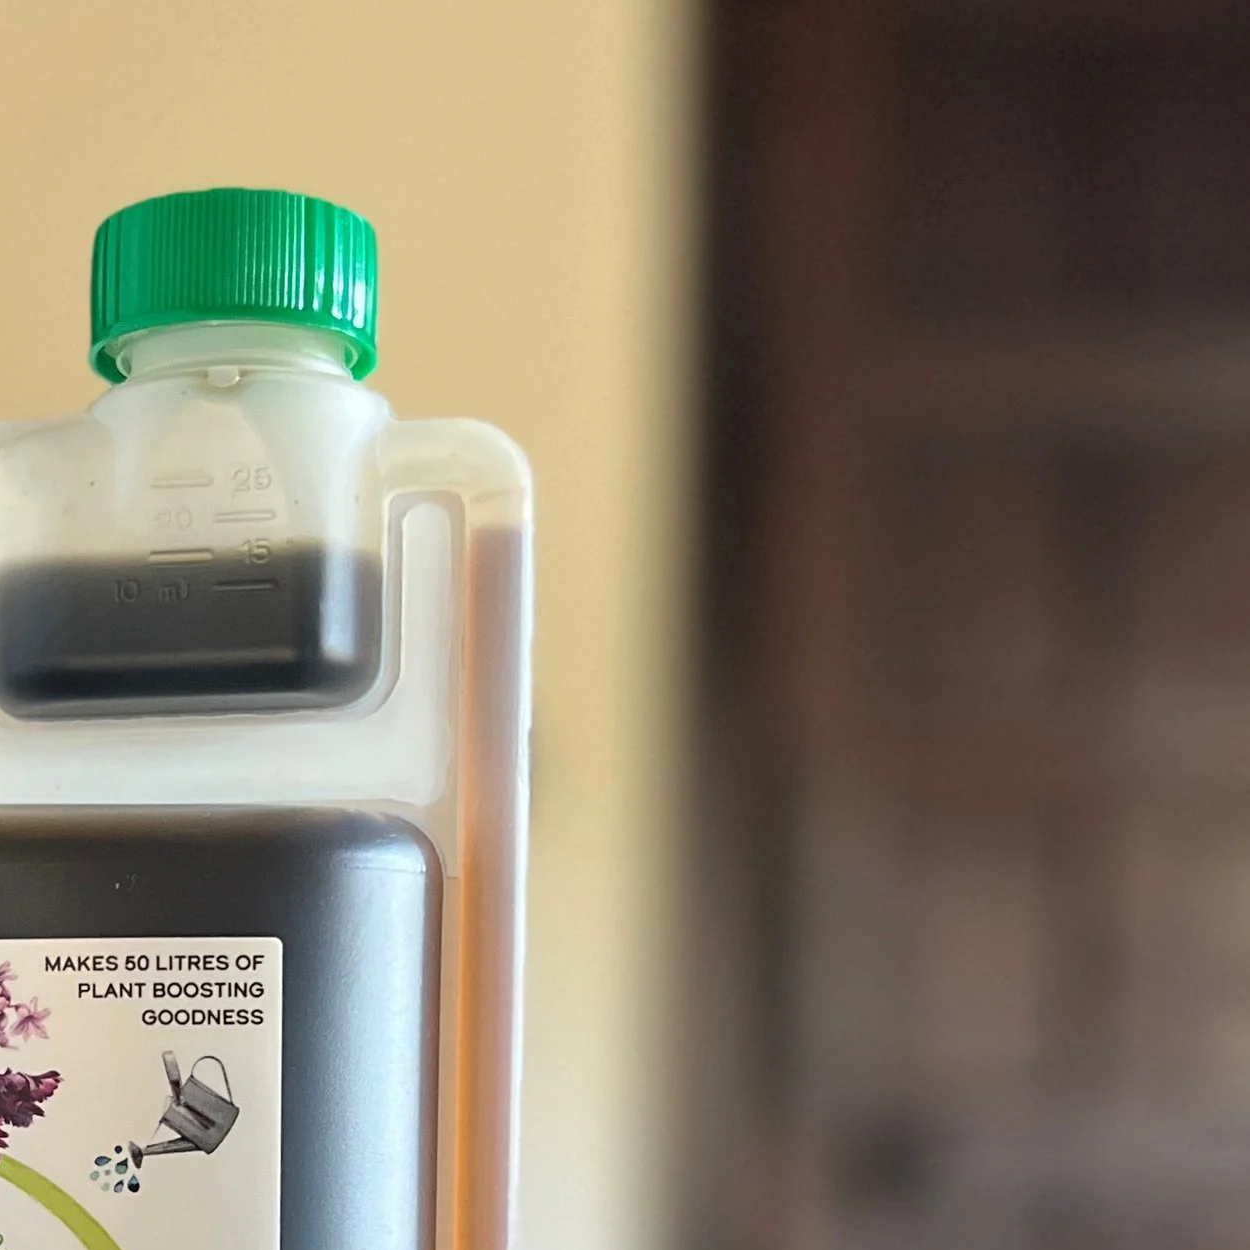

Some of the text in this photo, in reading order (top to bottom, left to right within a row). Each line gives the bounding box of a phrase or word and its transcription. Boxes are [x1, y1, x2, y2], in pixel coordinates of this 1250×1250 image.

[231, 465, 272, 492] 25
[241, 538, 271, 564] 15
[113, 578, 189, 602] 10 ml
[45, 954, 265, 972] MAKES 50 LITRES OF
[78, 982, 265, 999] PLANT BOOSTING
[142, 1009, 264, 1025] GOODNESS
